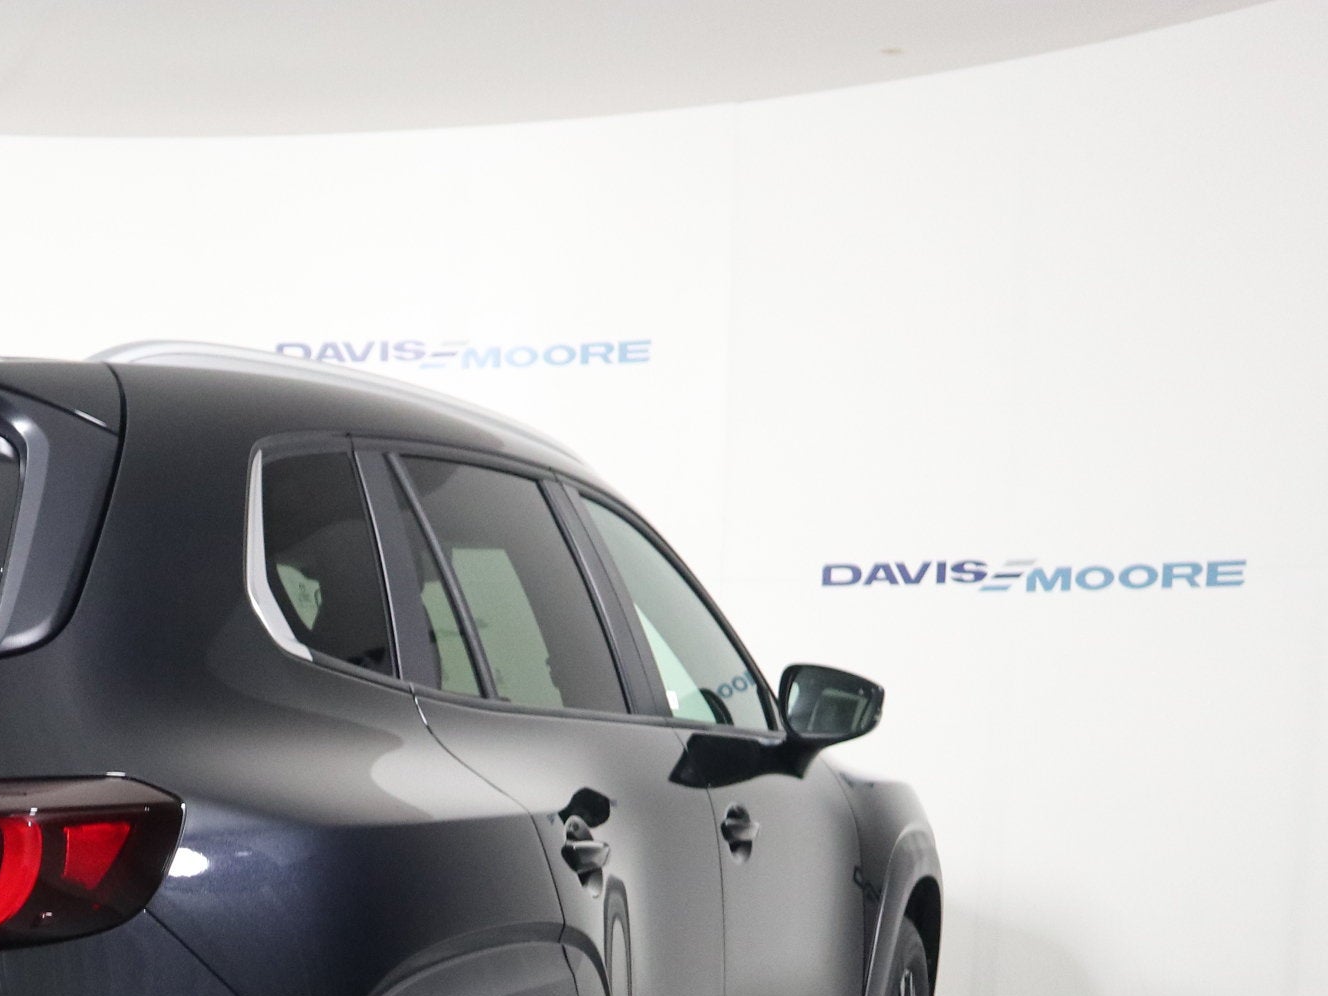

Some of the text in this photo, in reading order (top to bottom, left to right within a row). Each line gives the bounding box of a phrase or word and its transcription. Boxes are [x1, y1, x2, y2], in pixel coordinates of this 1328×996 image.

[275, 340, 653, 369] DAVIS MOORE
[821, 559, 1248, 593] DAVIS MOORE
